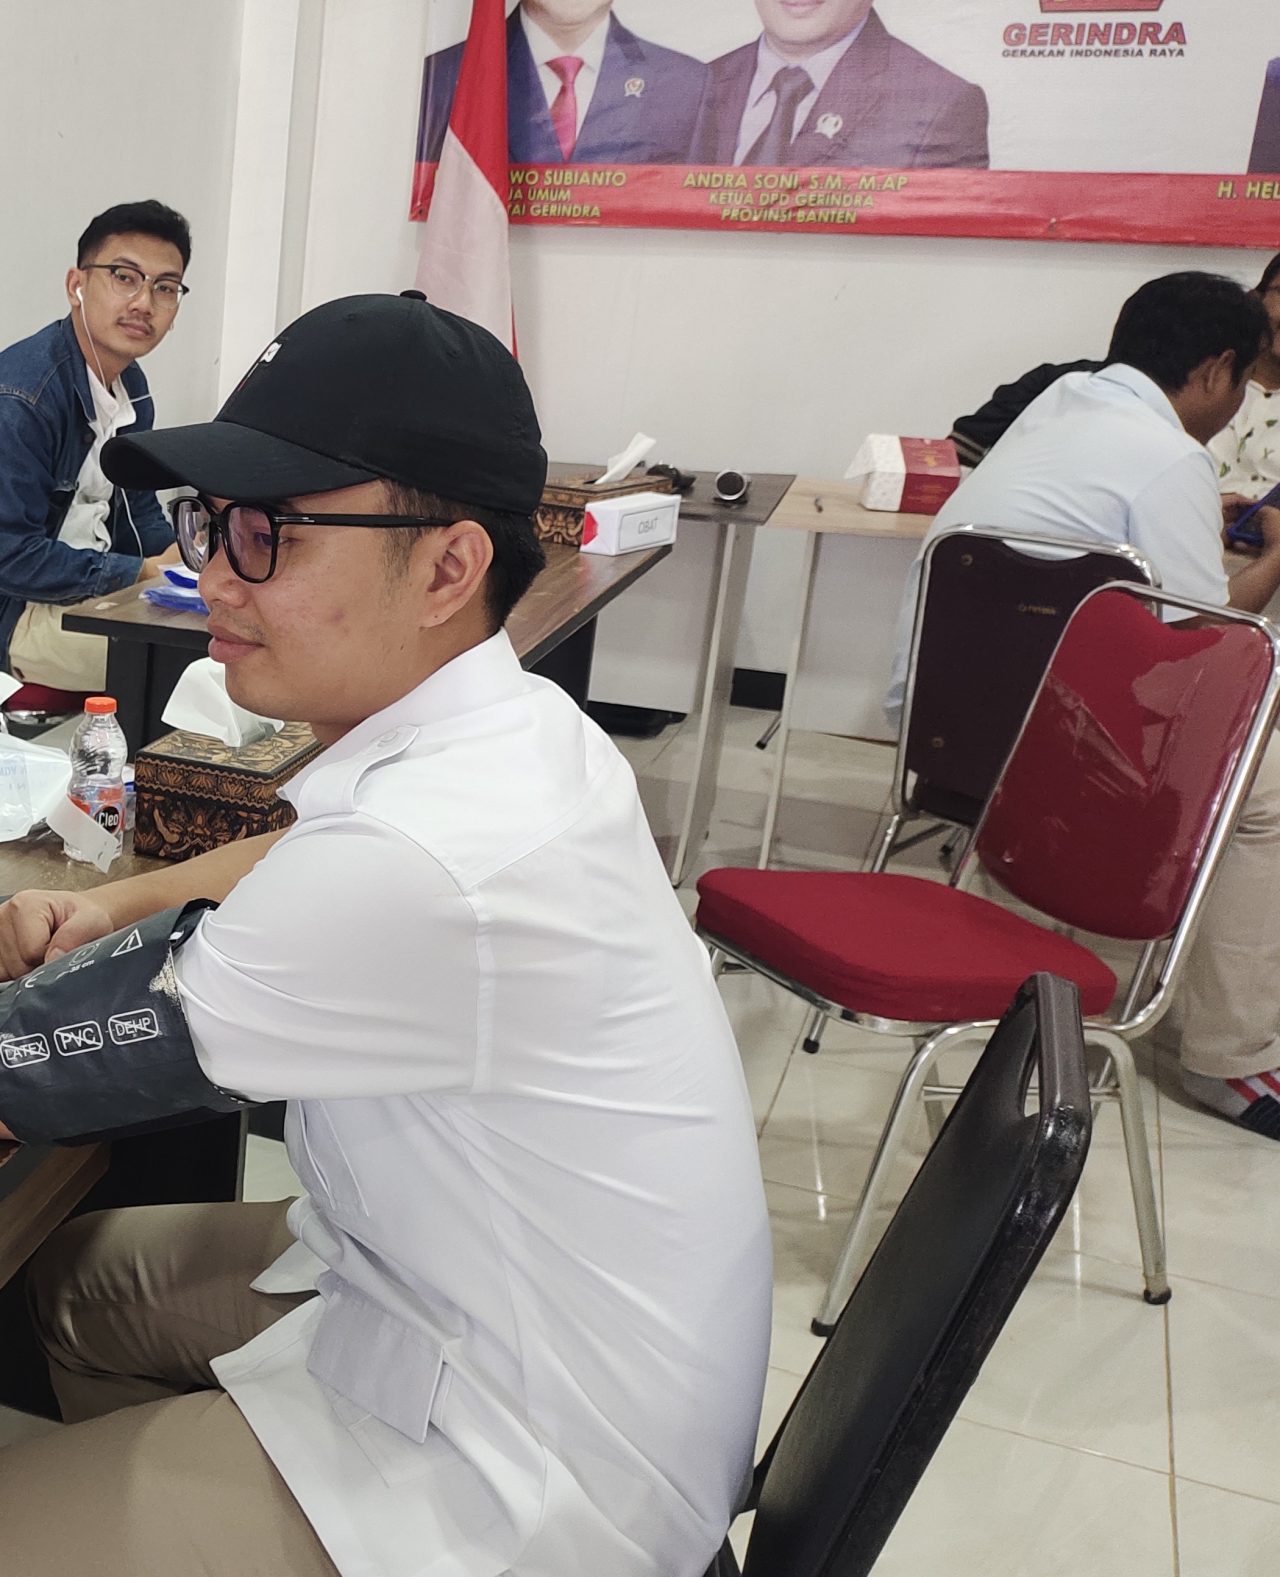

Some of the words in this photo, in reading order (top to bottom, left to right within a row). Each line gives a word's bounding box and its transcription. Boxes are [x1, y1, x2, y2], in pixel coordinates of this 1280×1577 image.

[1002, 22, 1187, 47] GERINDRA
[1001, 48, 1065, 58] GERAKAN
[1070, 48, 1144, 58] INDONESIA
[1149, 48, 1185, 58] RAYA
[543, 170, 627, 187] SUBIANTO
[683, 172, 748, 189] ANDRA
[858, 175, 909, 191] M.AP
[528, 187, 571, 201] UMUM
[1217, 180, 1237, 199] H.
[709, 191, 754, 205] KETUA
[759, 192, 790, 206] DPD
[794, 192, 874, 207] GERINDRA
[529, 204, 601, 217] GERINDRA
[721, 207, 791, 222] PROVINSI
[796, 209, 857, 223] BANTEN
[638, 517, 658, 535] OBAT
[99, 812, 119, 827] Cleo
[115, 1017, 151, 1036] DEHP
[60, 1027, 96, 1050] PVC
[5, 1040, 46, 1060] LATEX
